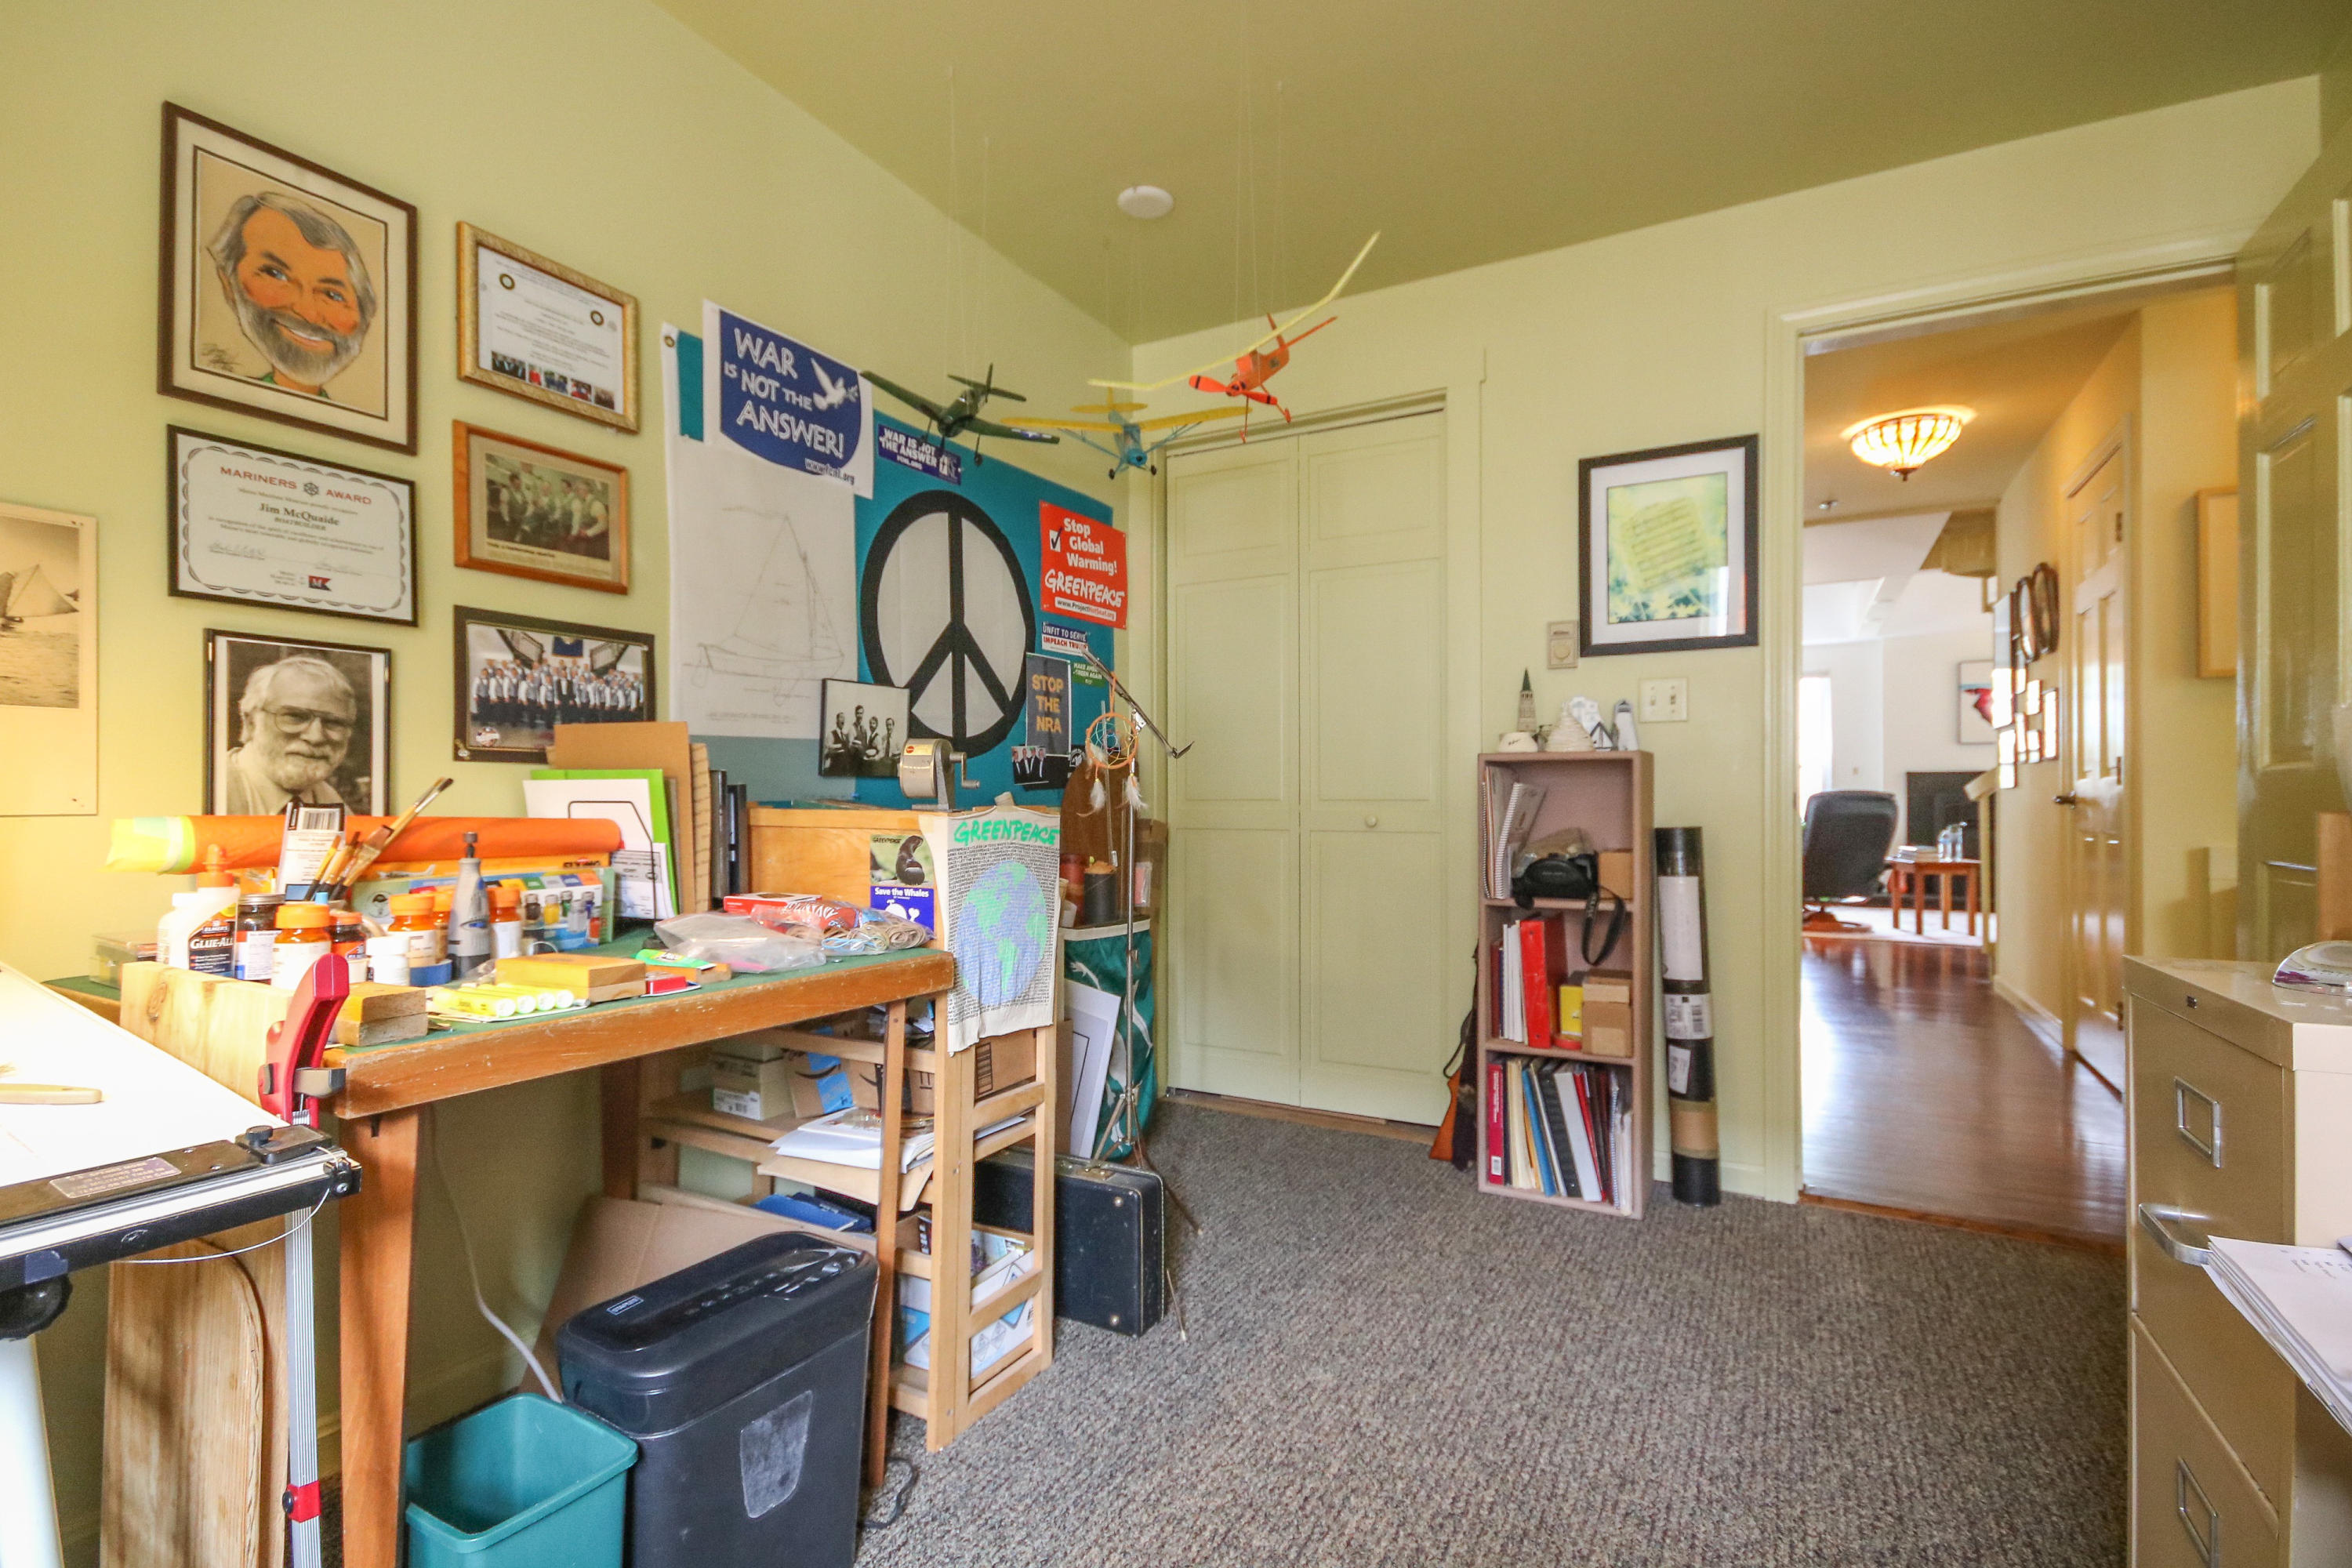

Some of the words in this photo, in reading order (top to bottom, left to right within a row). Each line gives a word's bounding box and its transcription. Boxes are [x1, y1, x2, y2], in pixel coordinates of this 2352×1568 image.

[734, 328, 798, 379] WAR
[724, 361, 738, 379] IS
[741, 368, 780, 401] NOT
[782, 387, 813, 412] THE
[736, 400, 845, 460] ANSWER!
[884, 427, 906, 445] WAR
[907, 437, 917, 448] IS
[881, 439, 898, 453] THE
[899, 445, 938, 467] ANSWER
[220, 466, 298, 490] MARINERS
[325, 488, 372, 505] AWARD
[258, 503, 280, 515] Jim
[284, 507, 339, 526] McQuaide
[1063, 517, 1091, 538] Stop
[1069, 535, 1105, 555] Global
[1066, 553, 1118, 576] Warming!
[1044, 568, 1125, 608] GREENPEACE
[1043, 624, 1060, 635] UNFIT
[1061, 629, 1069, 637] TO
[1069, 631, 1087, 642] SERVE
[1043, 636, 1067, 646] IMPEACH
[1032, 673, 1065, 693] STOP
[1035, 695, 1061, 713] THE
[1036, 716, 1062, 734] NRA
[953, 819, 1061, 846] GREENPEACE
[891, 887, 903, 896] the
[904, 888, 929, 898] Whales
